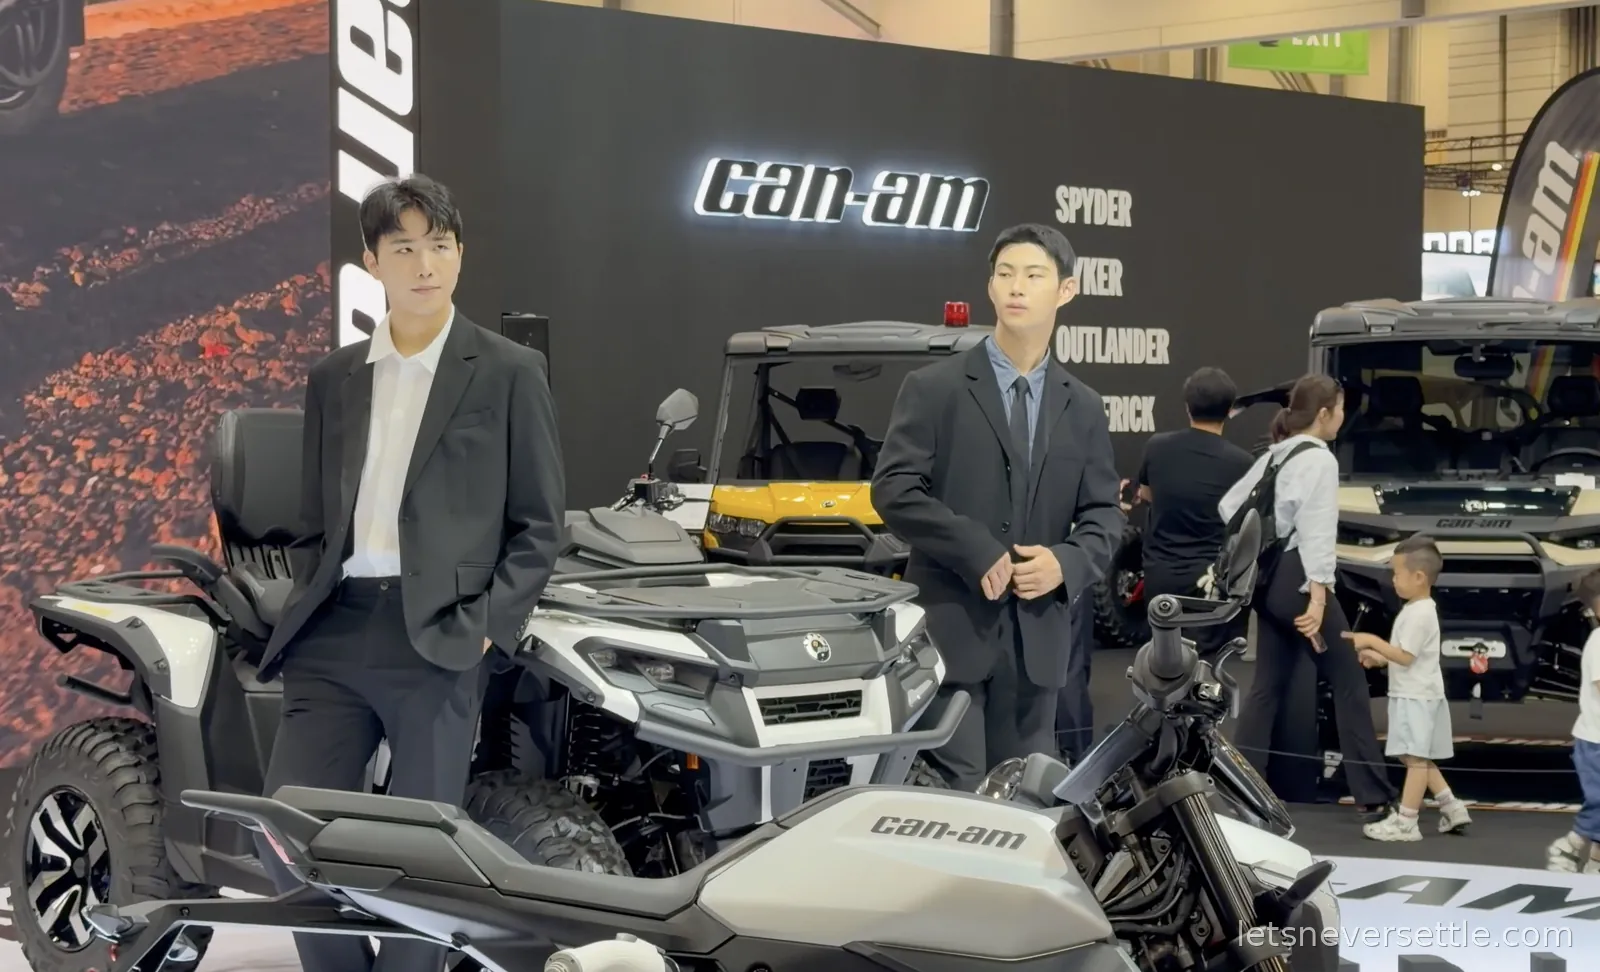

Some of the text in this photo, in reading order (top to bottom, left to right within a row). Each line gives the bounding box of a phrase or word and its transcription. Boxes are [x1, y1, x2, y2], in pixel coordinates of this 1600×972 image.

[694, 157, 989, 232] can-am
[1055, 184, 1132, 227] SPYDER
[1512, 141, 1579, 298] -am
[1072, 256, 1123, 296] YKER
[1056, 324, 1170, 364] OUTLANDER
[871, 815, 1027, 850] can-am
